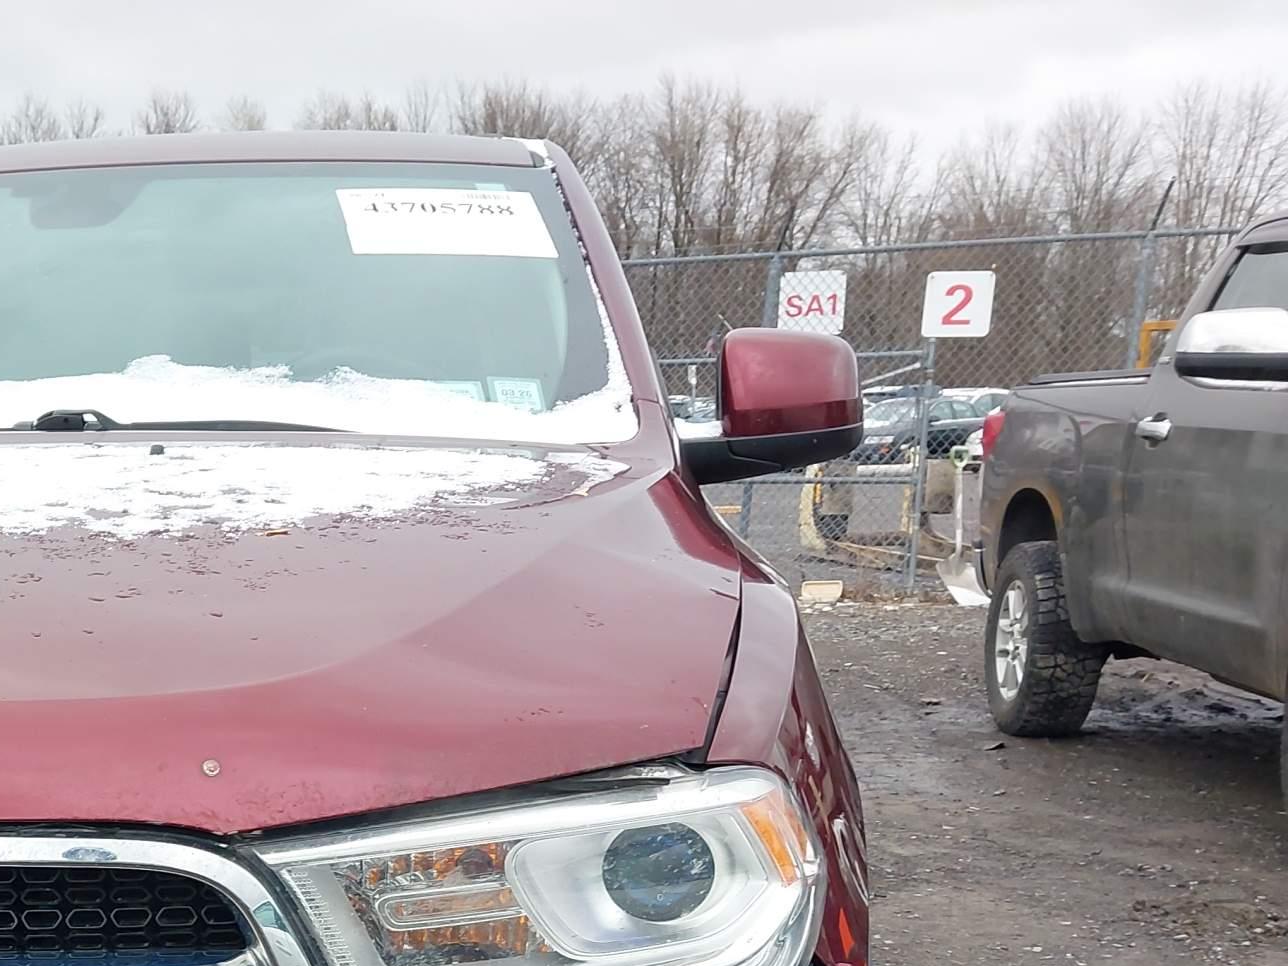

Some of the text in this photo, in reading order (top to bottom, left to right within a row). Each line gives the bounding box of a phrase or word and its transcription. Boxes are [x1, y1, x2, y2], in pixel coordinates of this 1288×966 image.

[363, 201, 515, 216] 43705788
[785, 293, 838, 318] SA1
[941, 284, 974, 325] 2
